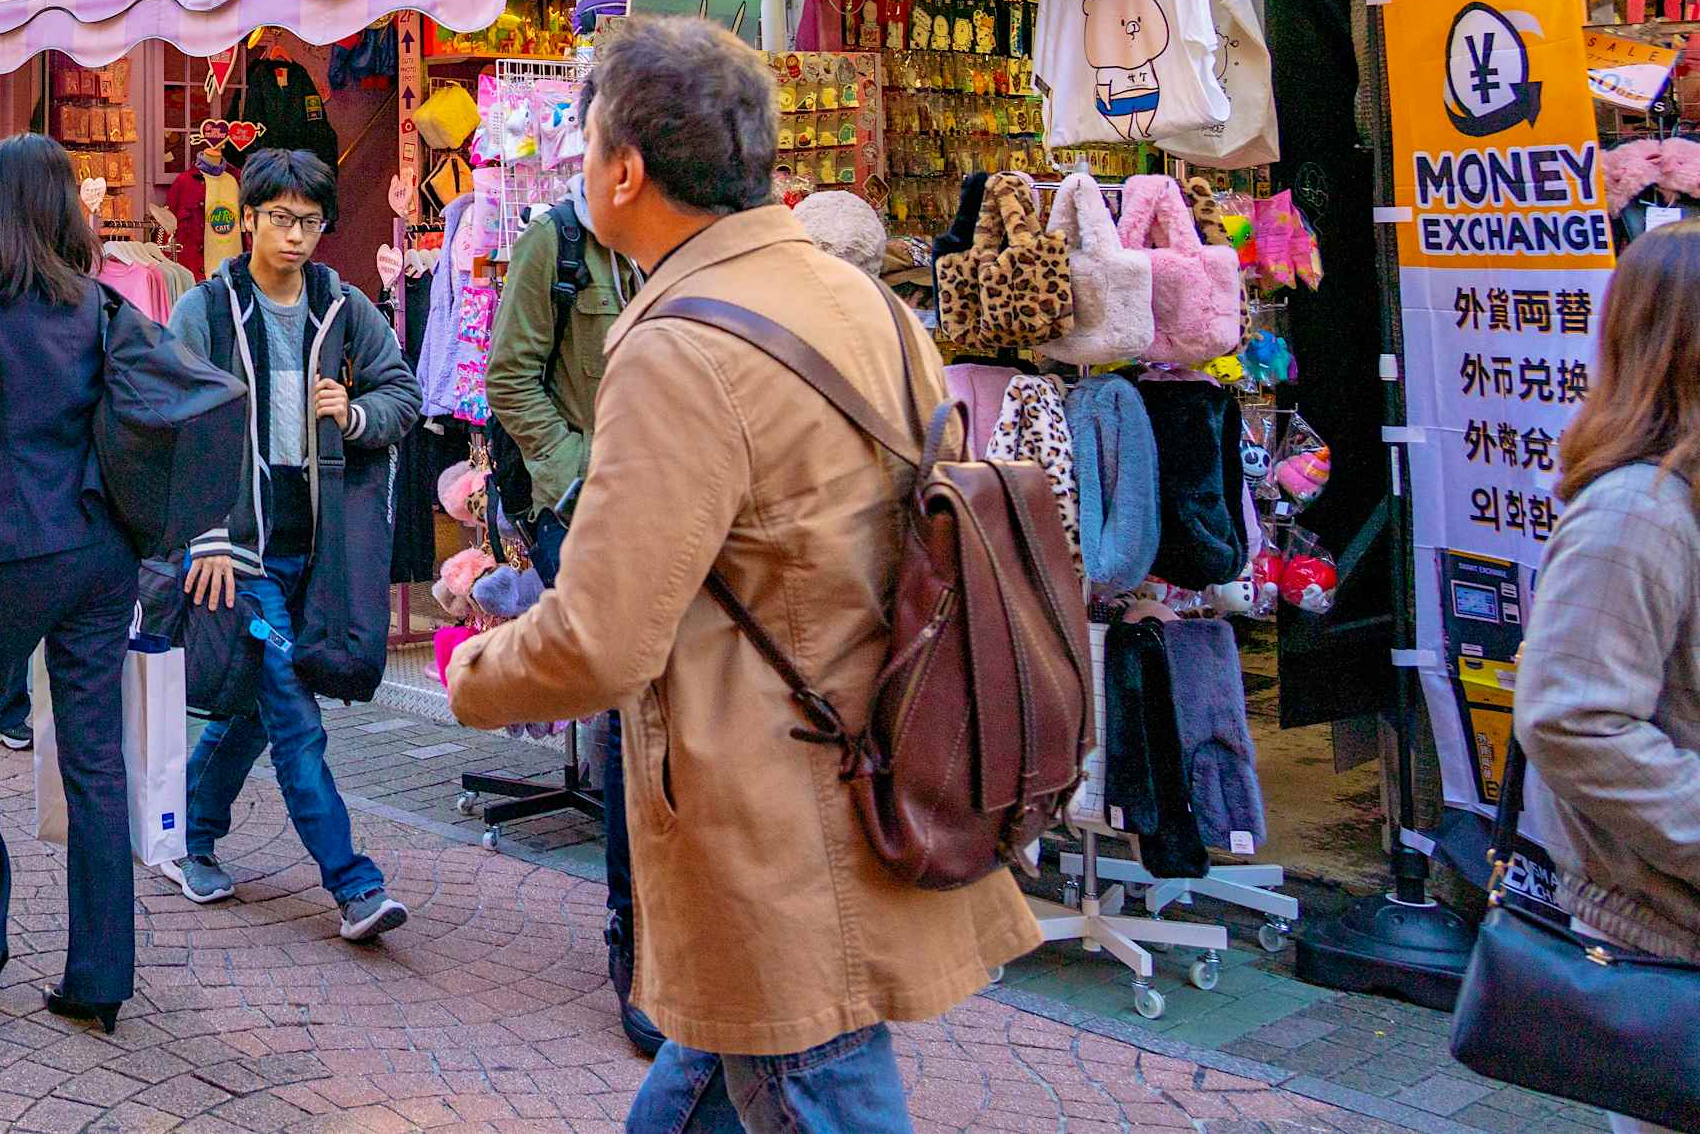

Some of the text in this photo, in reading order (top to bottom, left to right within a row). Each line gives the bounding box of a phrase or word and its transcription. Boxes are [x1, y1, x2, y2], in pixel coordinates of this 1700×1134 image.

[1415, 146, 1597, 206] MONEY
[1421, 213, 1610, 253] EXCHANGE
[1454, 286, 1592, 335] 外貨両替
[1463, 419, 1558, 472] 外幣兌
